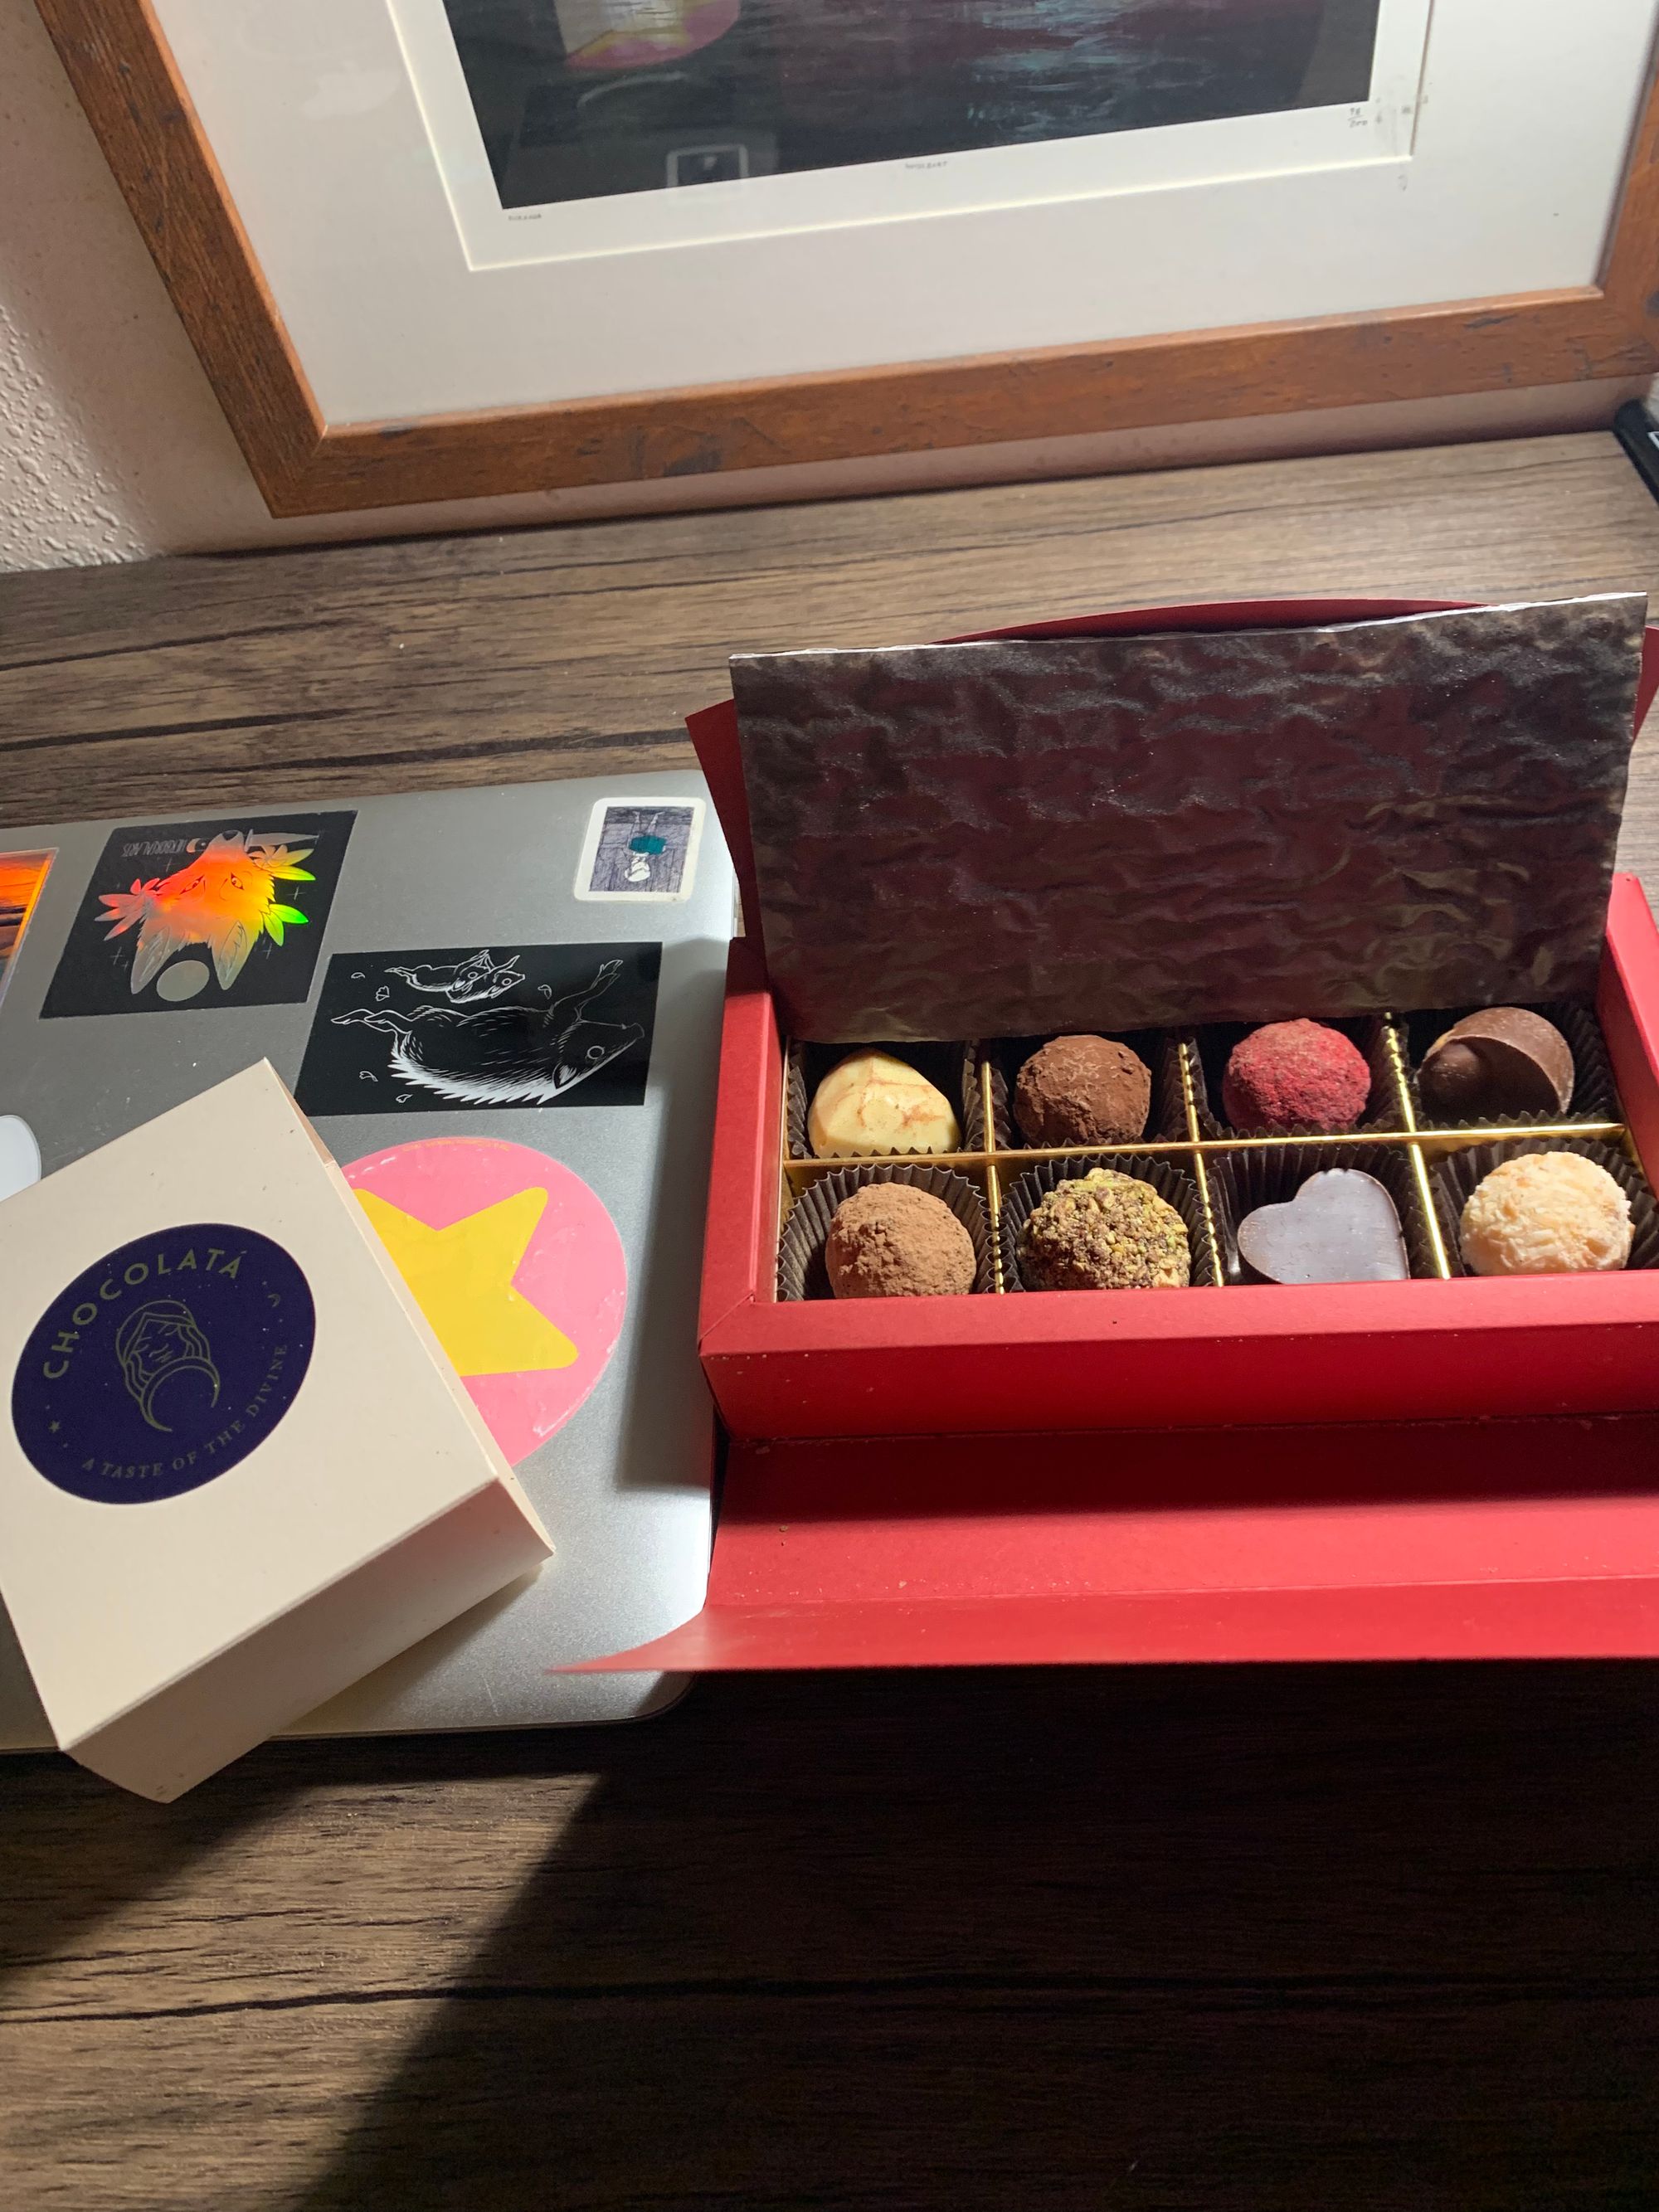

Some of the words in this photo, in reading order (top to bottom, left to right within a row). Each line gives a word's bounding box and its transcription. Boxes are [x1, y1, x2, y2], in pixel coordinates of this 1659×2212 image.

[82, 1457, 95, 1471] A
[100, 1461, 163, 1479] TASTE
[172, 1451, 197, 1471] OF
[204, 1419, 245, 1454] THE
[245, 1344, 288, 1417] DIVINE
